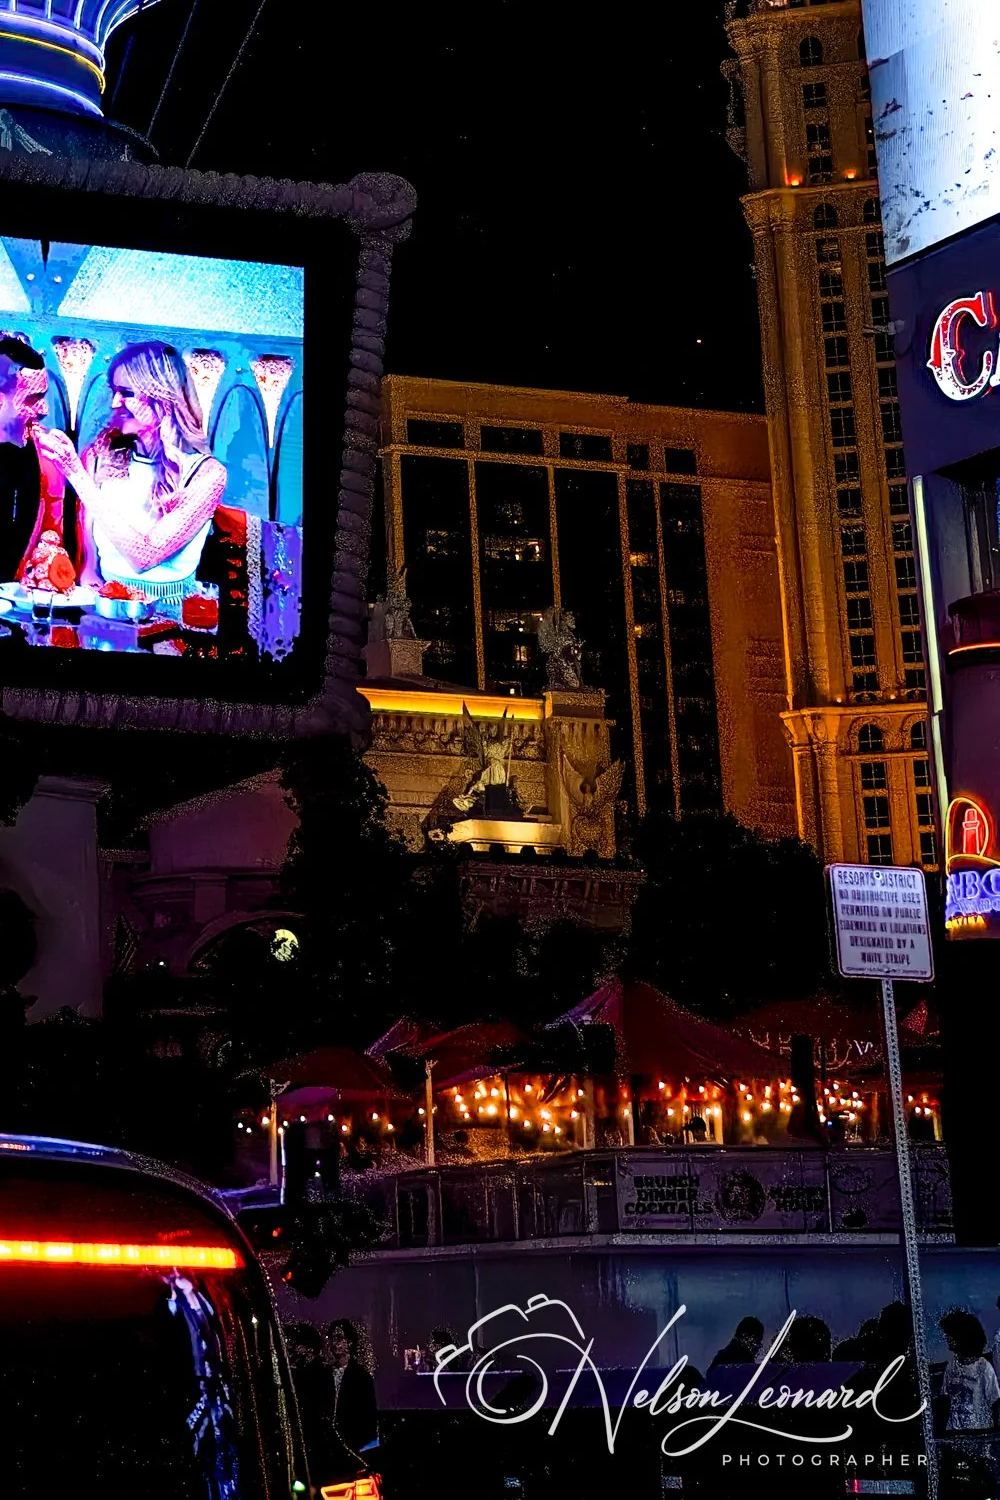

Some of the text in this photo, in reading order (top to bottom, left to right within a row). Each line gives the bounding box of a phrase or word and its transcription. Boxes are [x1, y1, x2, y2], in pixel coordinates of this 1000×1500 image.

[837, 870, 917, 888] RESORTS DISTRICT
[624, 1201, 715, 1215] COCKTAILS
